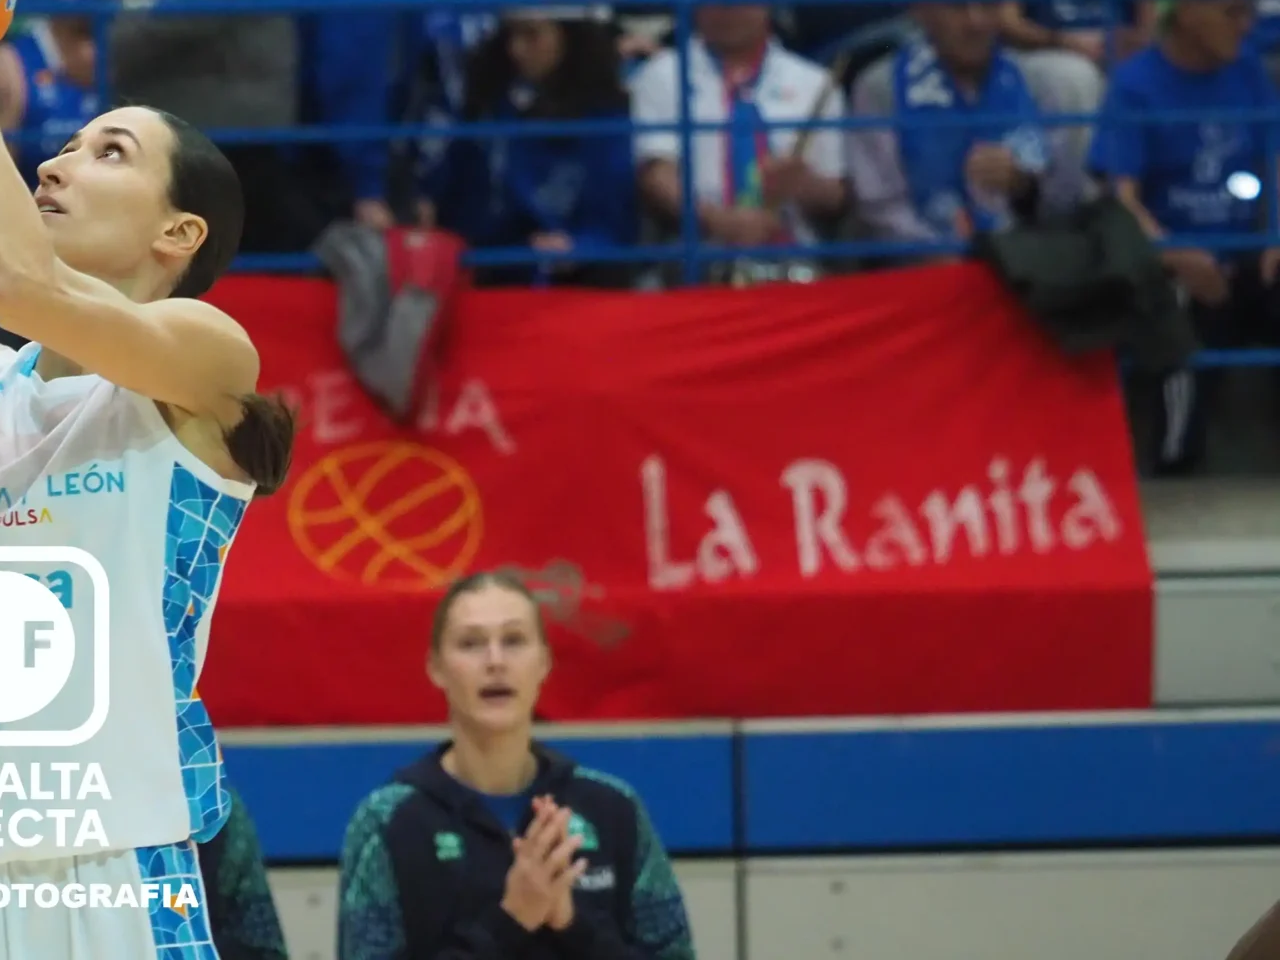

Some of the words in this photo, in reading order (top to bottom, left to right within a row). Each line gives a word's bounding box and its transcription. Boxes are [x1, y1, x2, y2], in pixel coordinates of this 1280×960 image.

[281, 372, 518, 456] EA
[47, 463, 125, 497] LEÓN
[640, 454, 759, 591] La
[779, 454, 1122, 579] Ranita
